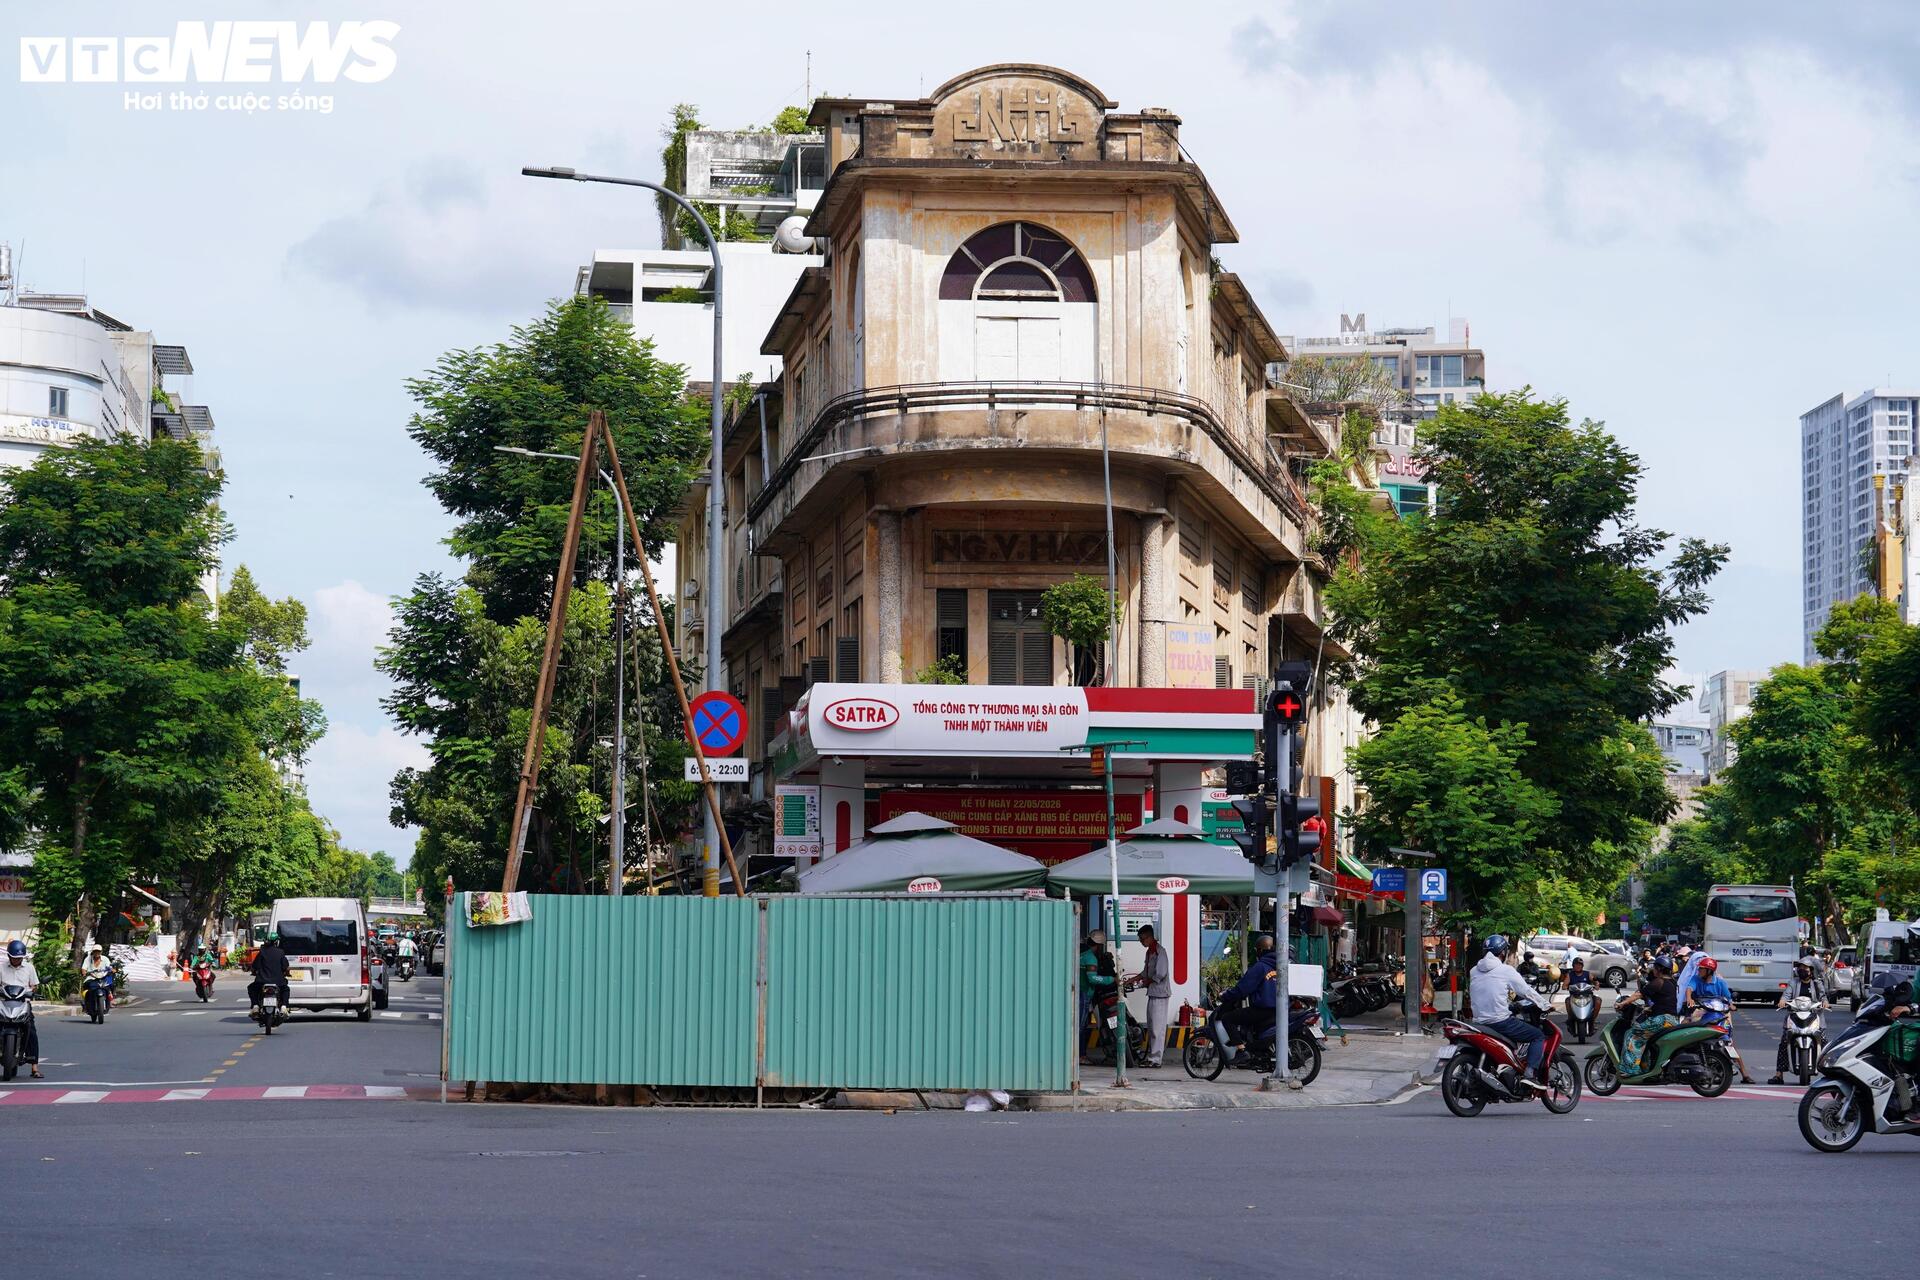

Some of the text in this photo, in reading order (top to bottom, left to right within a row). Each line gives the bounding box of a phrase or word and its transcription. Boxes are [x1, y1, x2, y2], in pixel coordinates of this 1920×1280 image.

[1341, 313, 1365, 332] M
[31, 418, 73, 431] HOTEL
[836, 706, 887, 722] SATRA
[940, 701, 966, 714] CÔNG
[968, 704, 980, 715] TY
[982, 703, 1020, 715] THƯƠNG
[1022, 704, 1039, 718] MẠI
[1042, 702, 1057, 716] SÀI
[1059, 702, 1079, 716] GÒN
[944, 718, 1048, 733] TNHH MỘT THÀNH VIÊN
[690, 764, 710, 775] 6:0
[719, 764, 744, 775] 22:00
[988, 798, 1011, 809] NGÀY
[968, 812, 992, 821] CUNG
[995, 809, 1012, 821] CẤP
[1014, 811, 1038, 822] XĂNG
[1040, 812, 1057, 822] R95
[961, 825, 990, 834] RON95
[992, 825, 1014, 834] THEO
[1016, 825, 1033, 834] QUY
[1035, 825, 1057, 837] ĐỊNH
[1059, 823, 1077, 834] CỦA
[1078, 823, 1106, 835] CHÍNH
[910, 881, 939, 893] SATRA
[1159, 879, 1187, 889] SATRA
[1732, 948, 1748, 957] 50LD
[1752, 948, 1773, 957] 197.26
